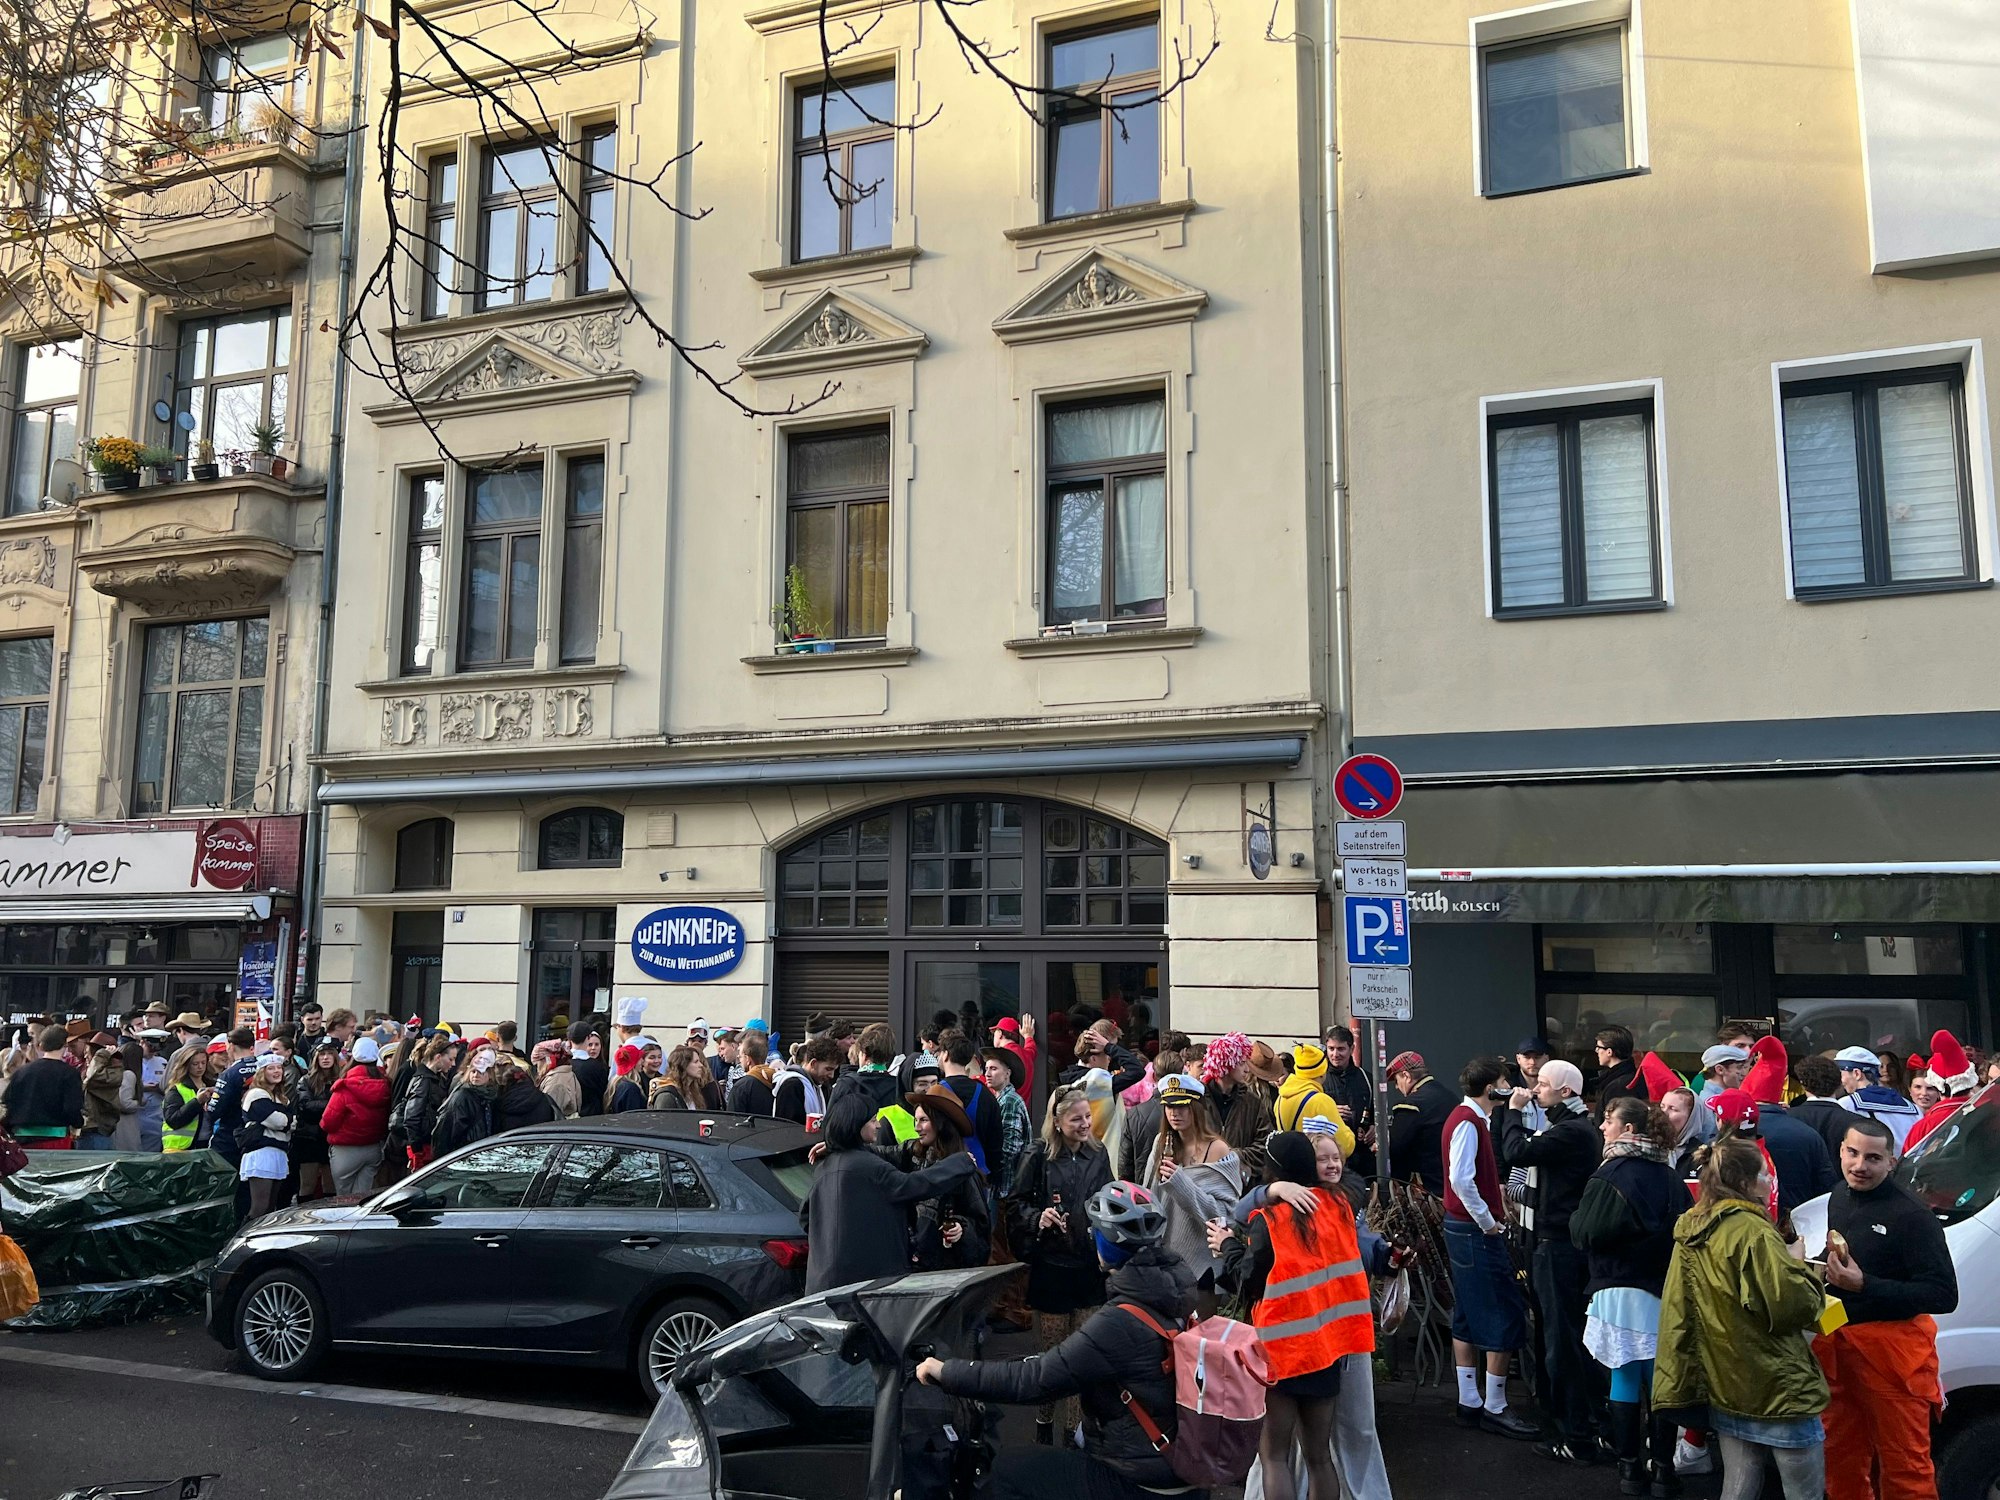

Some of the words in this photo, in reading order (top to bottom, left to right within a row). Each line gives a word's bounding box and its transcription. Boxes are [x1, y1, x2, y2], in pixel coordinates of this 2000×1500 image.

[1354, 830, 1368, 838] auf
[1370, 830, 1388, 838] dem
[204, 834, 255, 852] Speise-
[1343, 842, 1400, 850] Seitenstreifen
[201, 852, 255, 872] kammer
[1351, 866, 1399, 876] werktags
[1357, 878, 1364, 886] 8
[1375, 878, 1387, 886] 18
[1390, 878, 1397, 887] h
[1452, 901, 1500, 912] KÖLSCH
[454, 912, 461, 921] 16
[638, 918, 736, 947] WEINKNEIPE
[1355, 905, 1389, 956] P
[639, 948, 654, 963] ZUR
[655, 955, 676, 969] ALTEN
[1367, 973, 1378, 981] nur
[1362, 984, 1398, 993] Parkschein
[1356, 997, 1384, 1006] werktags
[1385, 997, 1390, 1006] 9
[1395, 998, 1403, 1006] 23
